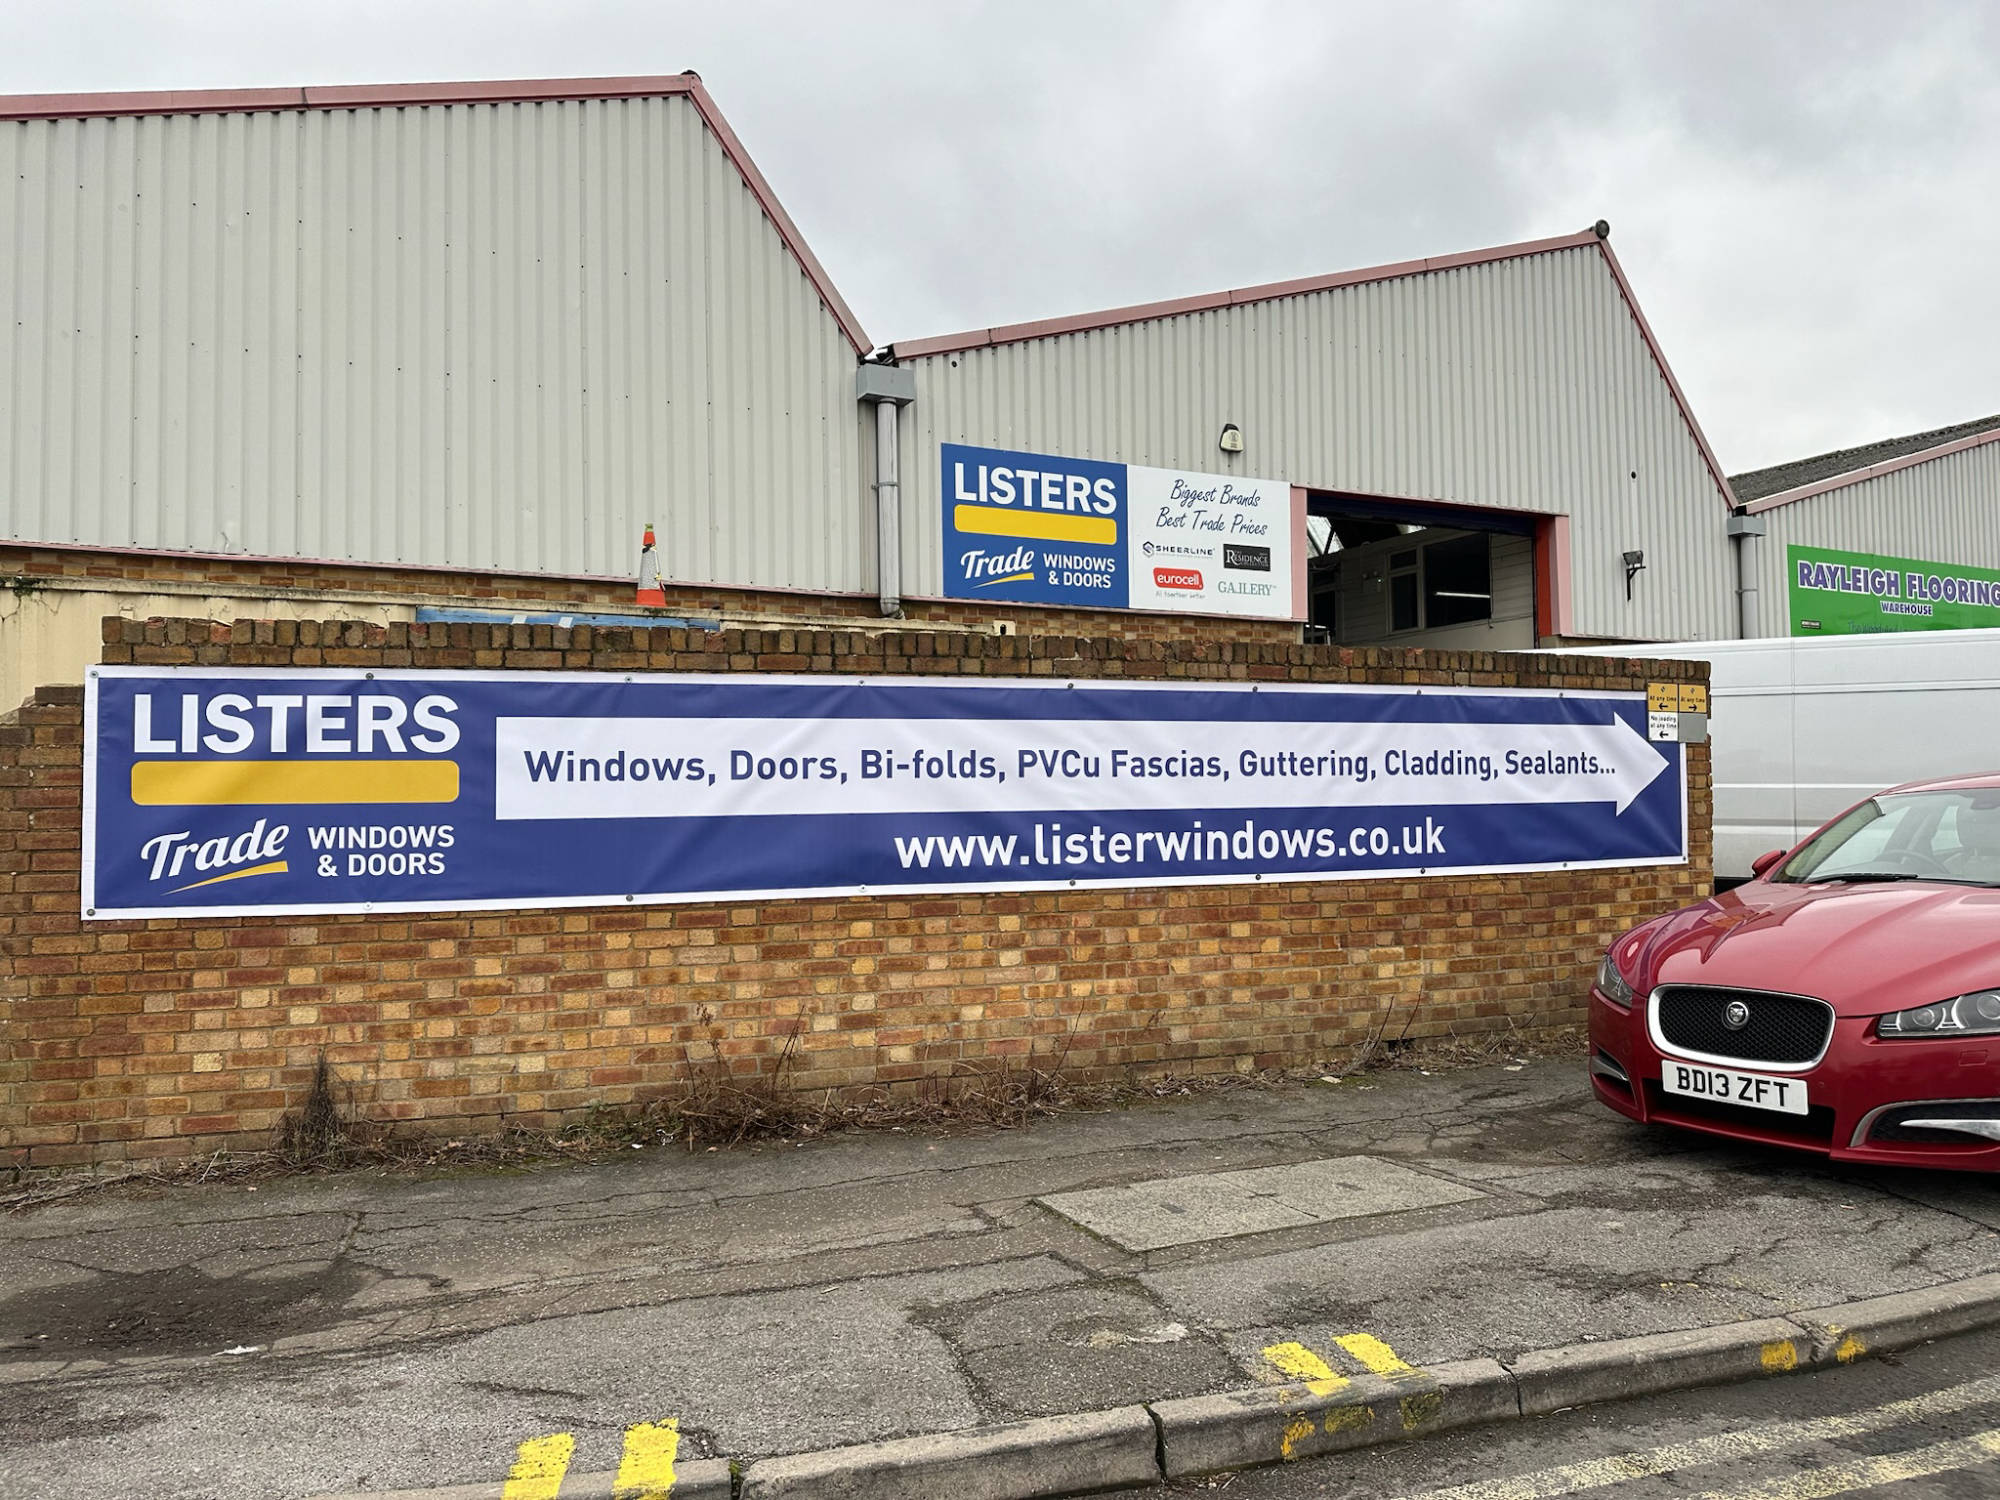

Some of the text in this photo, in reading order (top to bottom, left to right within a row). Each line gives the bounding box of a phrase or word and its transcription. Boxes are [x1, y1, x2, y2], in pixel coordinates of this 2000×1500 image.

[954, 462, 1118, 515] LISTERS
[1170, 478, 1261, 508] Biggest Brands
[1156, 506, 1268, 536] Best Trade Prices
[960, 546, 1034, 579] Trade
[1042, 552, 1116, 573] WINDOWS
[1155, 545, 1214, 556] SHEERLINE
[1048, 570, 1112, 589] & DOORS
[1156, 573, 1200, 586] eurocell
[1798, 560, 2000, 608] RAYLEIGH FLOORING
[1880, 600, 1933, 616] WAREHOUSE
[134, 693, 460, 754] LISTERS
[524, 748, 1616, 786] Windows, Doors, Bi-folds, PVCu Fascias, Guttering, Cladding, Sealants...
[140, 818, 289, 881] Trade
[307, 824, 454, 849] WINDOWS
[894, 816, 1446, 868] www.listerwindows.co.uk
[316, 852, 445, 877] & DOORS
[1676, 1066, 1790, 1107] BD13 ZFT
